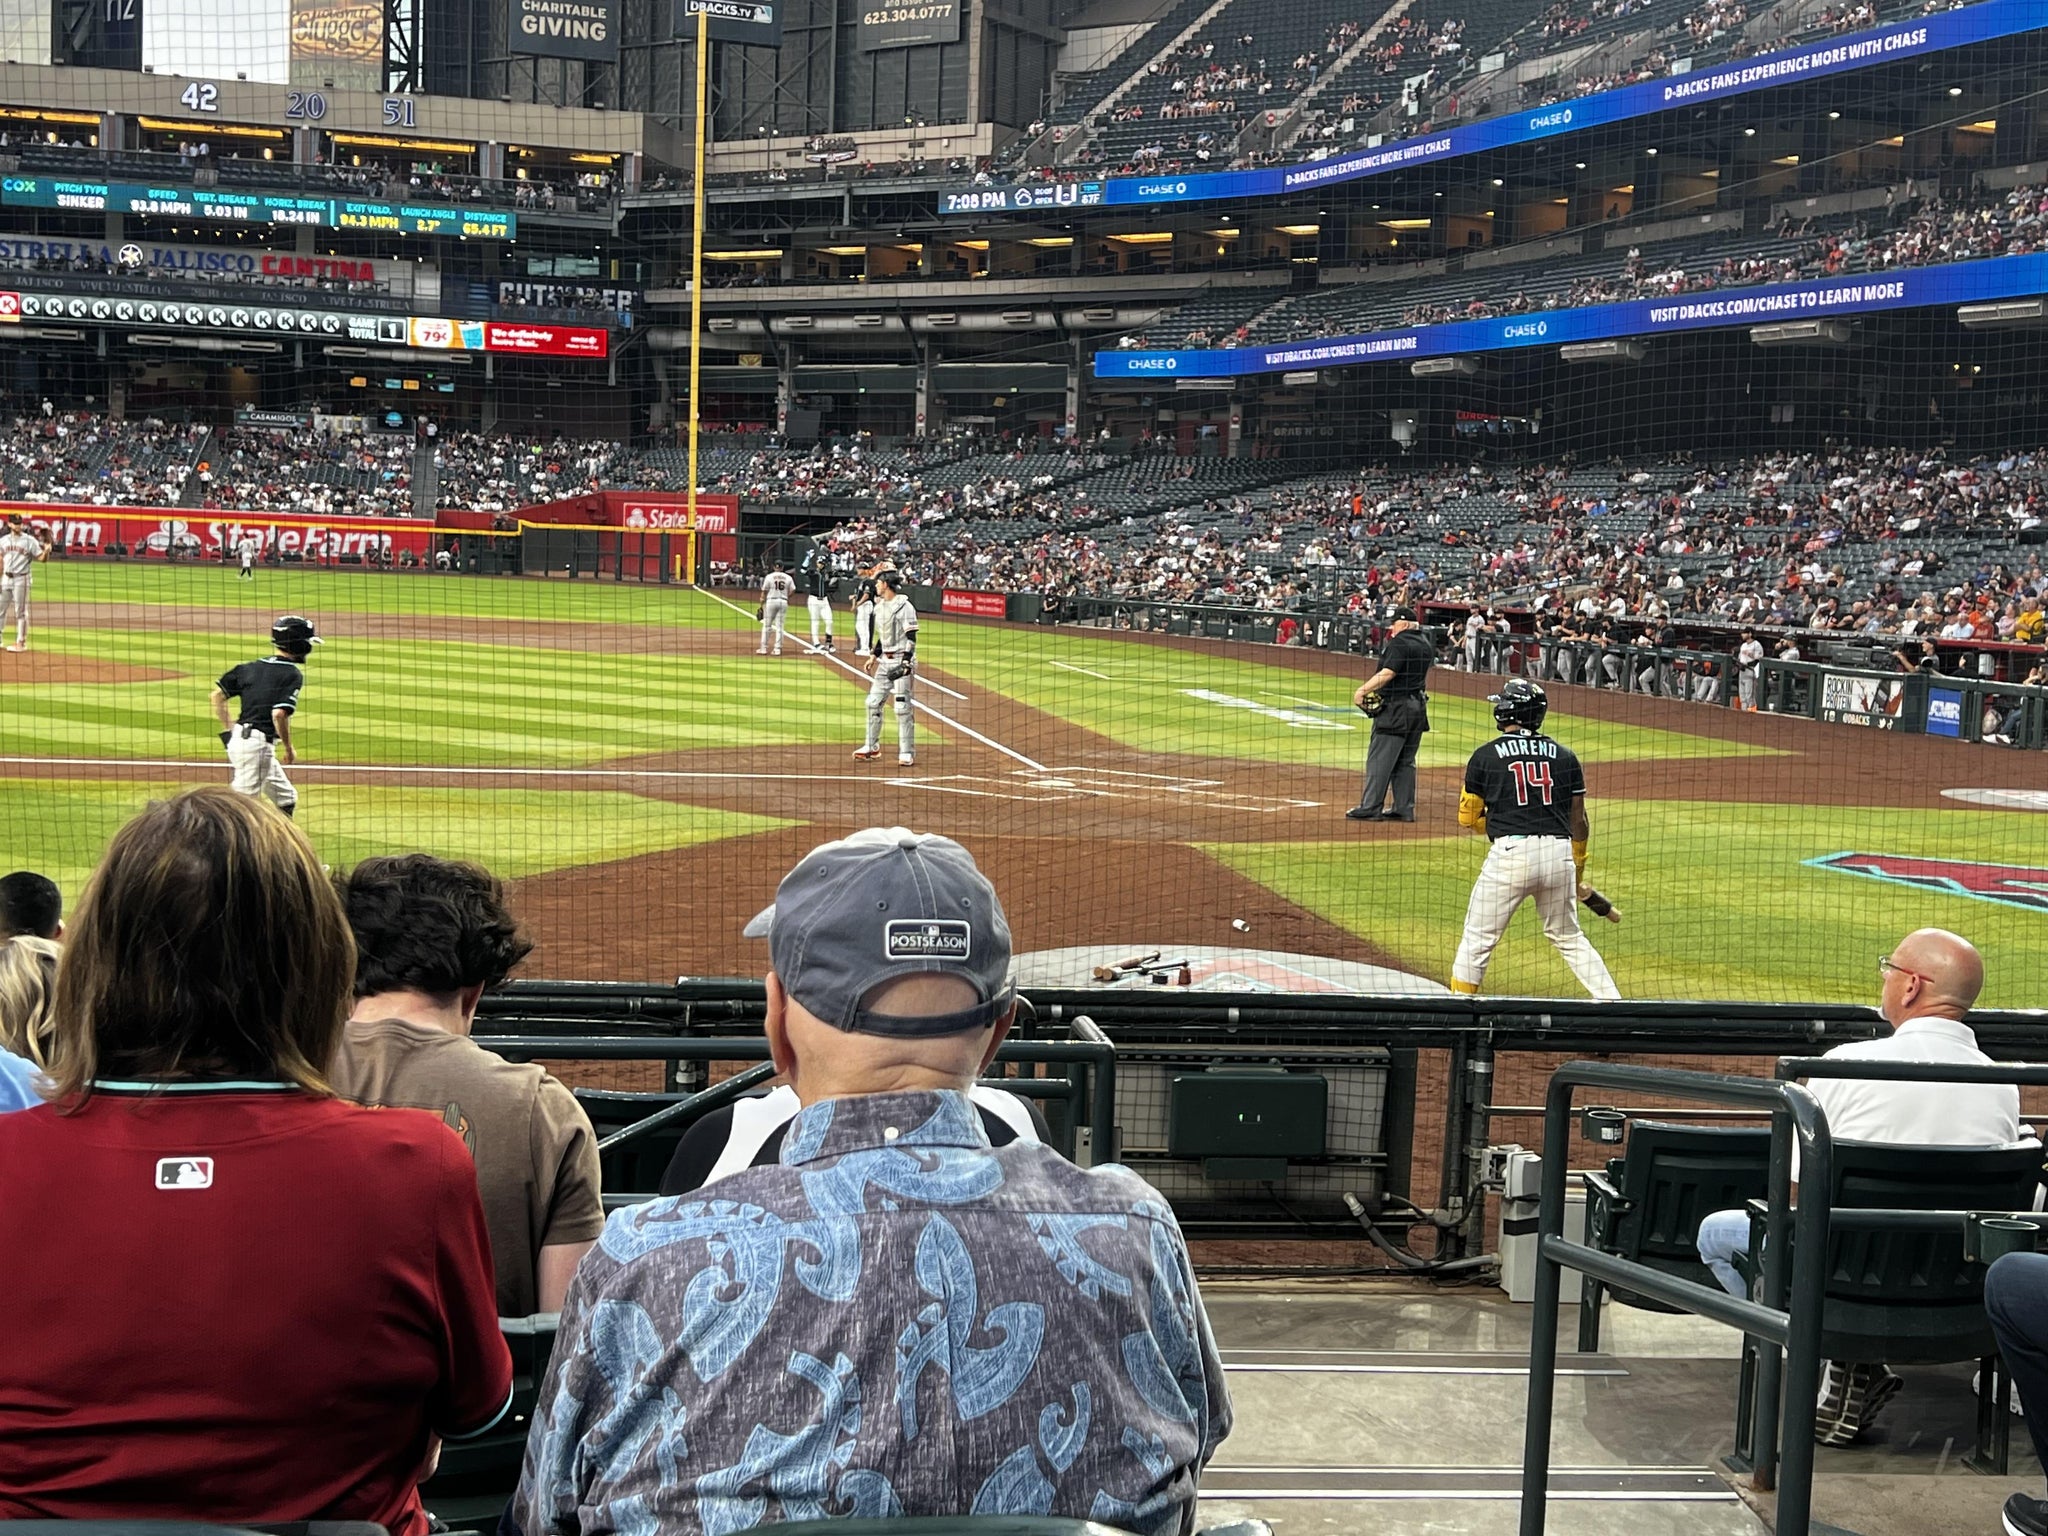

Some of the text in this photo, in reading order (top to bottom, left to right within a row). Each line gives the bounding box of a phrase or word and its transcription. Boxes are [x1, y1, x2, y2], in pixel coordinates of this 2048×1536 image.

[521, 0, 607, 19] CHARITABLE
[864, 4, 952, 25] 623.304.0777
[520, 15, 607, 41] GIVING
[1664, 29, 1927, 101] D-BACKS FANS EXPERIENCE MORE WITH CHASE
[181, 83, 218, 112] 42
[286, 92, 326, 119] 20
[383, 97, 416, 127] 51
[1530, 114, 1562, 130] CHASE
[1286, 138, 1451, 186] D-BACKS FANS EXPERIENCE MORE WITH CHASE
[2, 178, 36, 193] COX
[54, 183, 108, 196] PITCH TYPE
[1139, 184, 1175, 195] CHASE
[56, 194, 105, 210] SINKER
[148, 189, 179, 200] SPEED
[947, 191, 1006, 210] 7:08 PM
[160, 201, 192, 215] MPH
[203, 204, 248, 219] 5.03 IN
[296, 199, 326, 210] BREAK
[346, 203, 366, 214] EXIT
[305, 211, 320, 224] IN
[400, 207, 457, 220] LAUNCH ANGLE
[464, 211, 507, 223] DISTANCE
[369, 215, 399, 229] MPH
[491, 224, 508, 237] FT
[149, 248, 256, 273] JALISCO
[261, 254, 375, 282] CANTINA
[1651, 281, 1904, 323] VISIT DBACKS.COM/CHASE TO LEARN MORE
[348, 317, 376, 329] GAME
[388, 323, 397, 338] 1
[1504, 323, 1537, 337] CHASE
[348, 327, 377, 340] TOTAL
[1266, 336, 1417, 365] VISIT DBACKS.COM/CHASE TO LEARN MORE
[1128, 359, 1165, 369] CHASE
[250, 412, 296, 422] CASAMIGOS
[774, 580, 786, 591] 16
[1928, 699, 1960, 719] AMR
[1494, 738, 1557, 759] MORENO
[1508, 760, 1554, 807] 14
[890, 935, 967, 949] POSTSEASON
